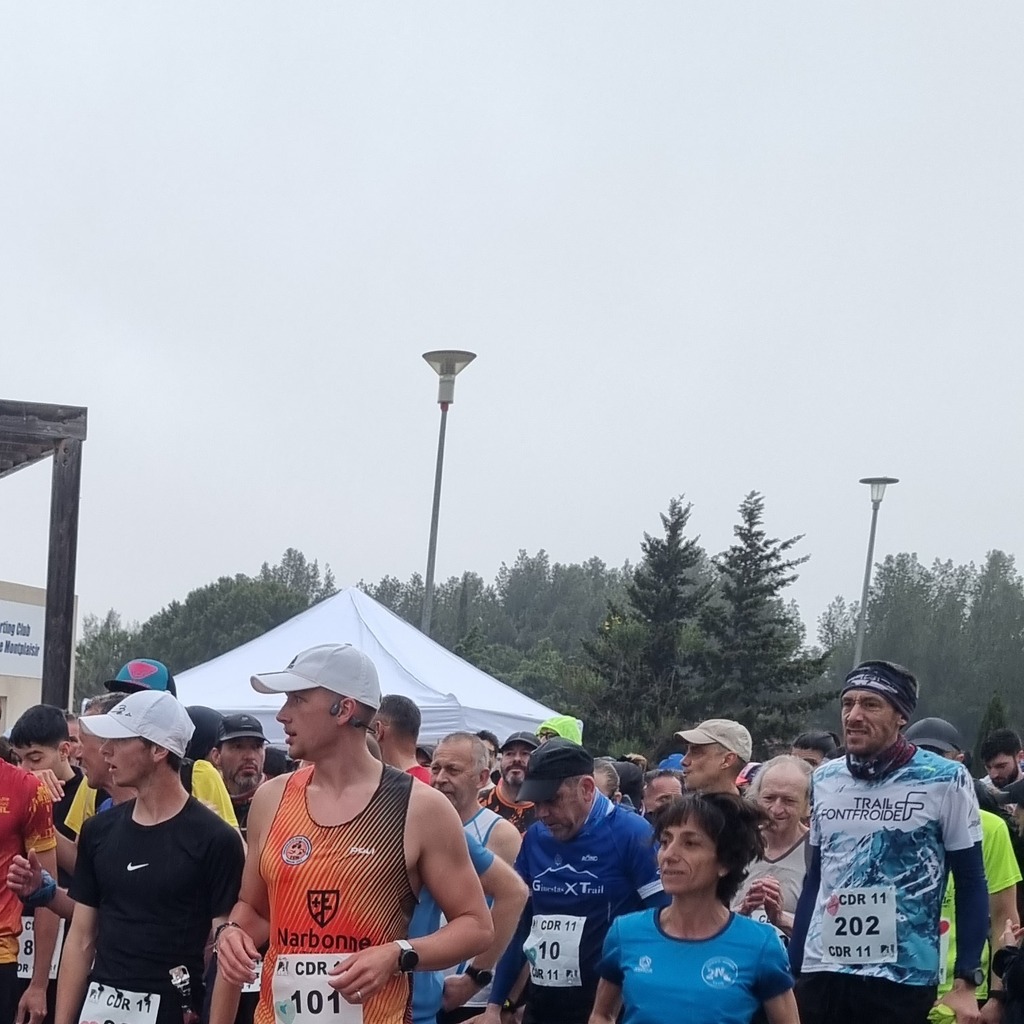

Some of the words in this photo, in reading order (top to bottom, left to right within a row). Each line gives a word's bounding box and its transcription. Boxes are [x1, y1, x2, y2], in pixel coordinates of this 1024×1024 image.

[16, 622, 30, 637] Club
[4, 639, 40, 657] Montplaisir
[853, 797, 890, 809] TRAIL
[822, 808, 902, 822] FONTFROIDE
[564, 882, 578, 896] X
[579, 882, 604, 894] Trail
[839, 894, 866, 906] CDR
[871, 892, 887, 905] 11
[540, 920, 562, 932] CDR
[565, 920, 577, 932] 11
[835, 916, 881, 937] 202
[277, 927, 373, 952] Narbonne
[538, 940, 561, 960] 10
[828, 946, 852, 958] CDR
[855, 945, 872, 958] 11
[295, 961, 328, 977] CDR
[547, 969, 559, 981] 11
[106, 994, 131, 1012] CDR
[290, 990, 340, 1015] 101
